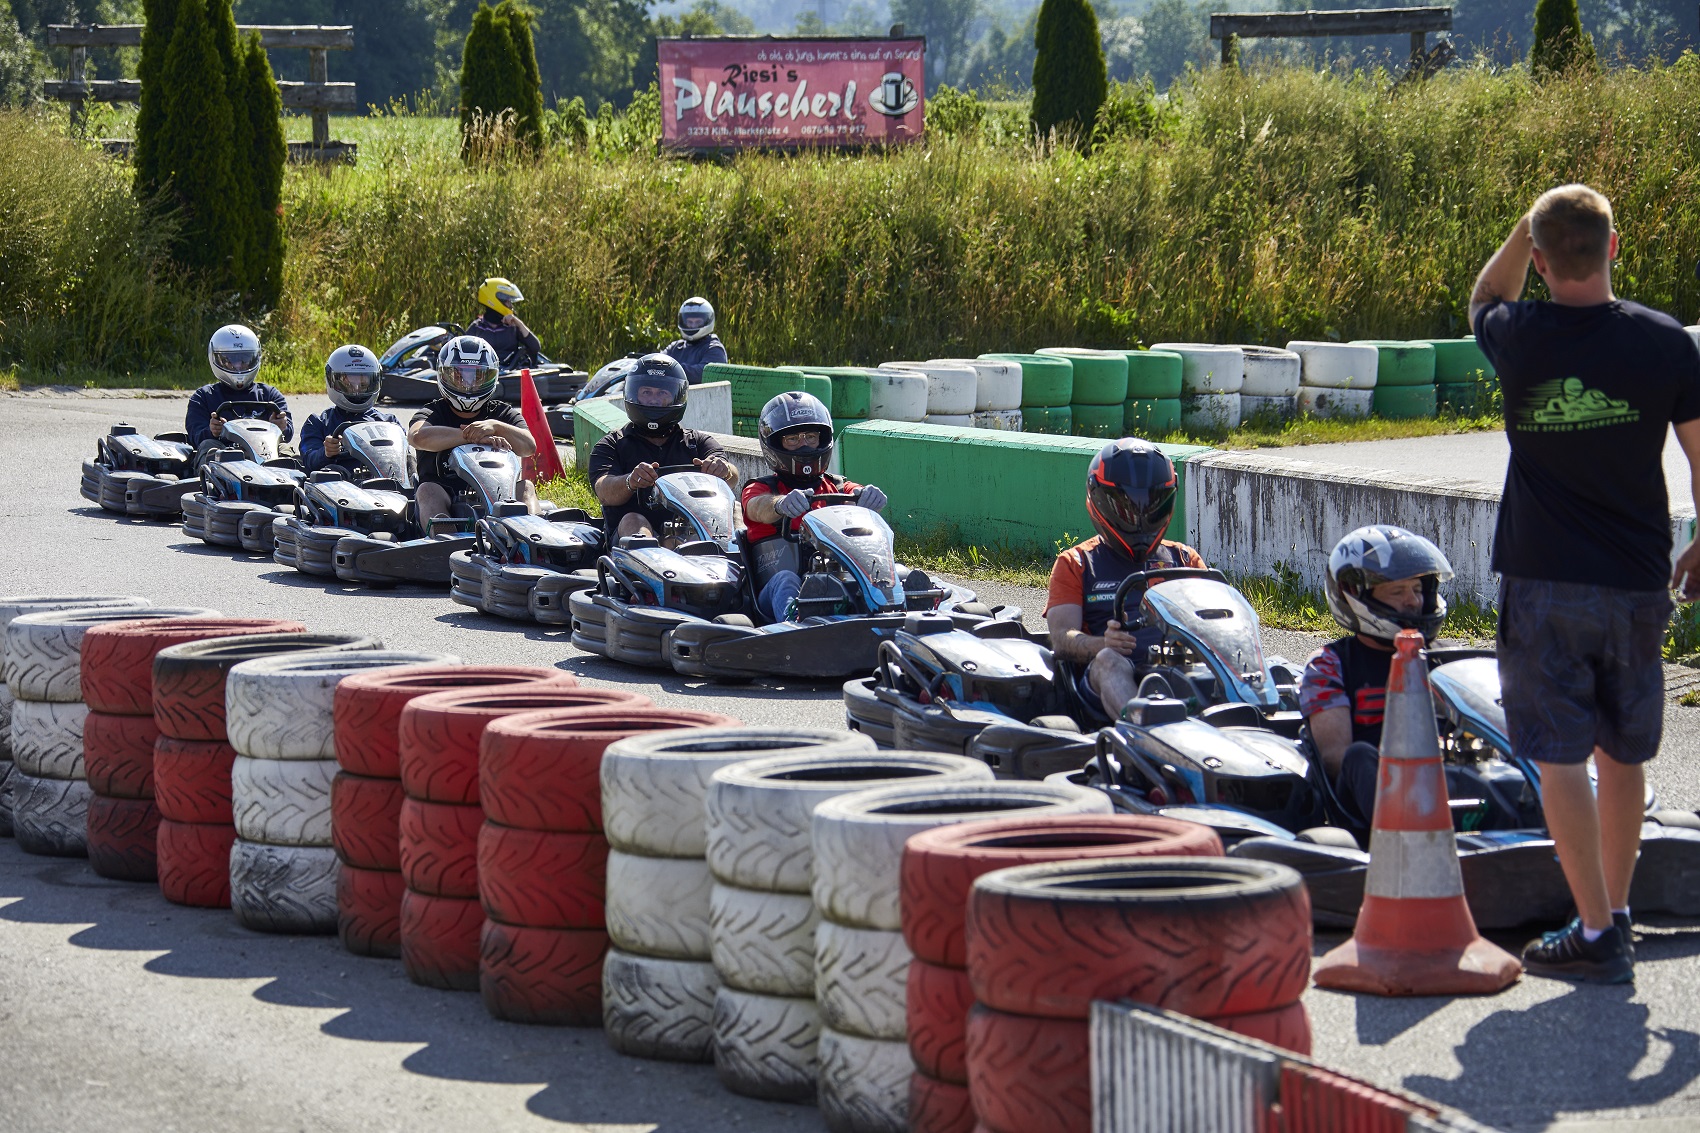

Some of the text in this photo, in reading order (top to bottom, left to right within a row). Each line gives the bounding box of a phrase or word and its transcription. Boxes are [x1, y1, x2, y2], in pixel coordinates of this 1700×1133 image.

[672, 77, 858, 122] Plauscherl
[733, 126, 780, 137] Marktplatz
[782, 126, 789, 135] 4
[1516, 415, 1640, 433] RACE SPEED BOOMERANG
